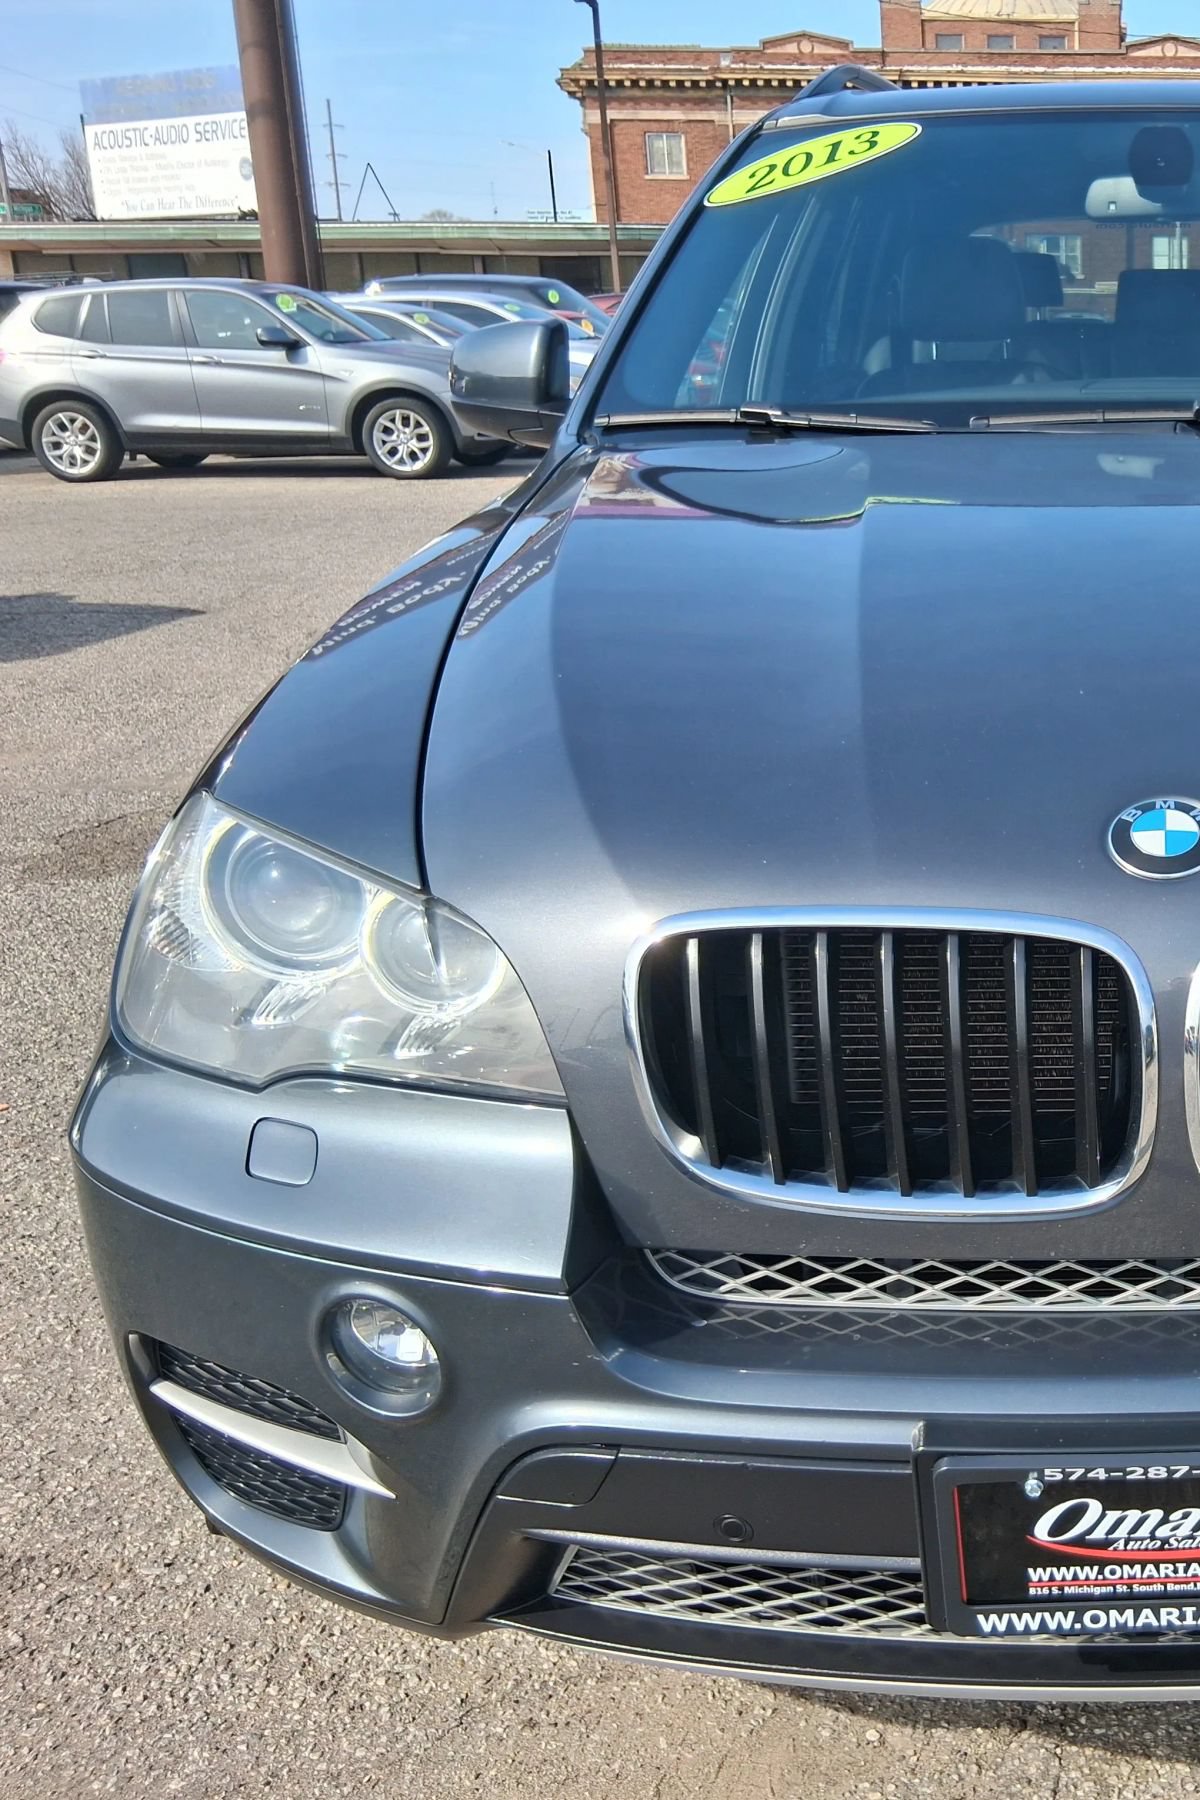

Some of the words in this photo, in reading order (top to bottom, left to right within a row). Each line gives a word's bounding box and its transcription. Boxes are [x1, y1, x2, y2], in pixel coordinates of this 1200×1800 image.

[194, 118, 247, 143] SERVICE
[745, 130, 880, 194] 2013
[178, 196, 193, 209] The
[1107, 1537, 1162, 1551] Auto
[1029, 1586, 1050, 1595] 816
[1052, 1586, 1062, 1595] S.
[1064, 1585, 1114, 1595] Michigan
[1116, 1584, 1131, 1592] St.
[1133, 1583, 1165, 1592] South
